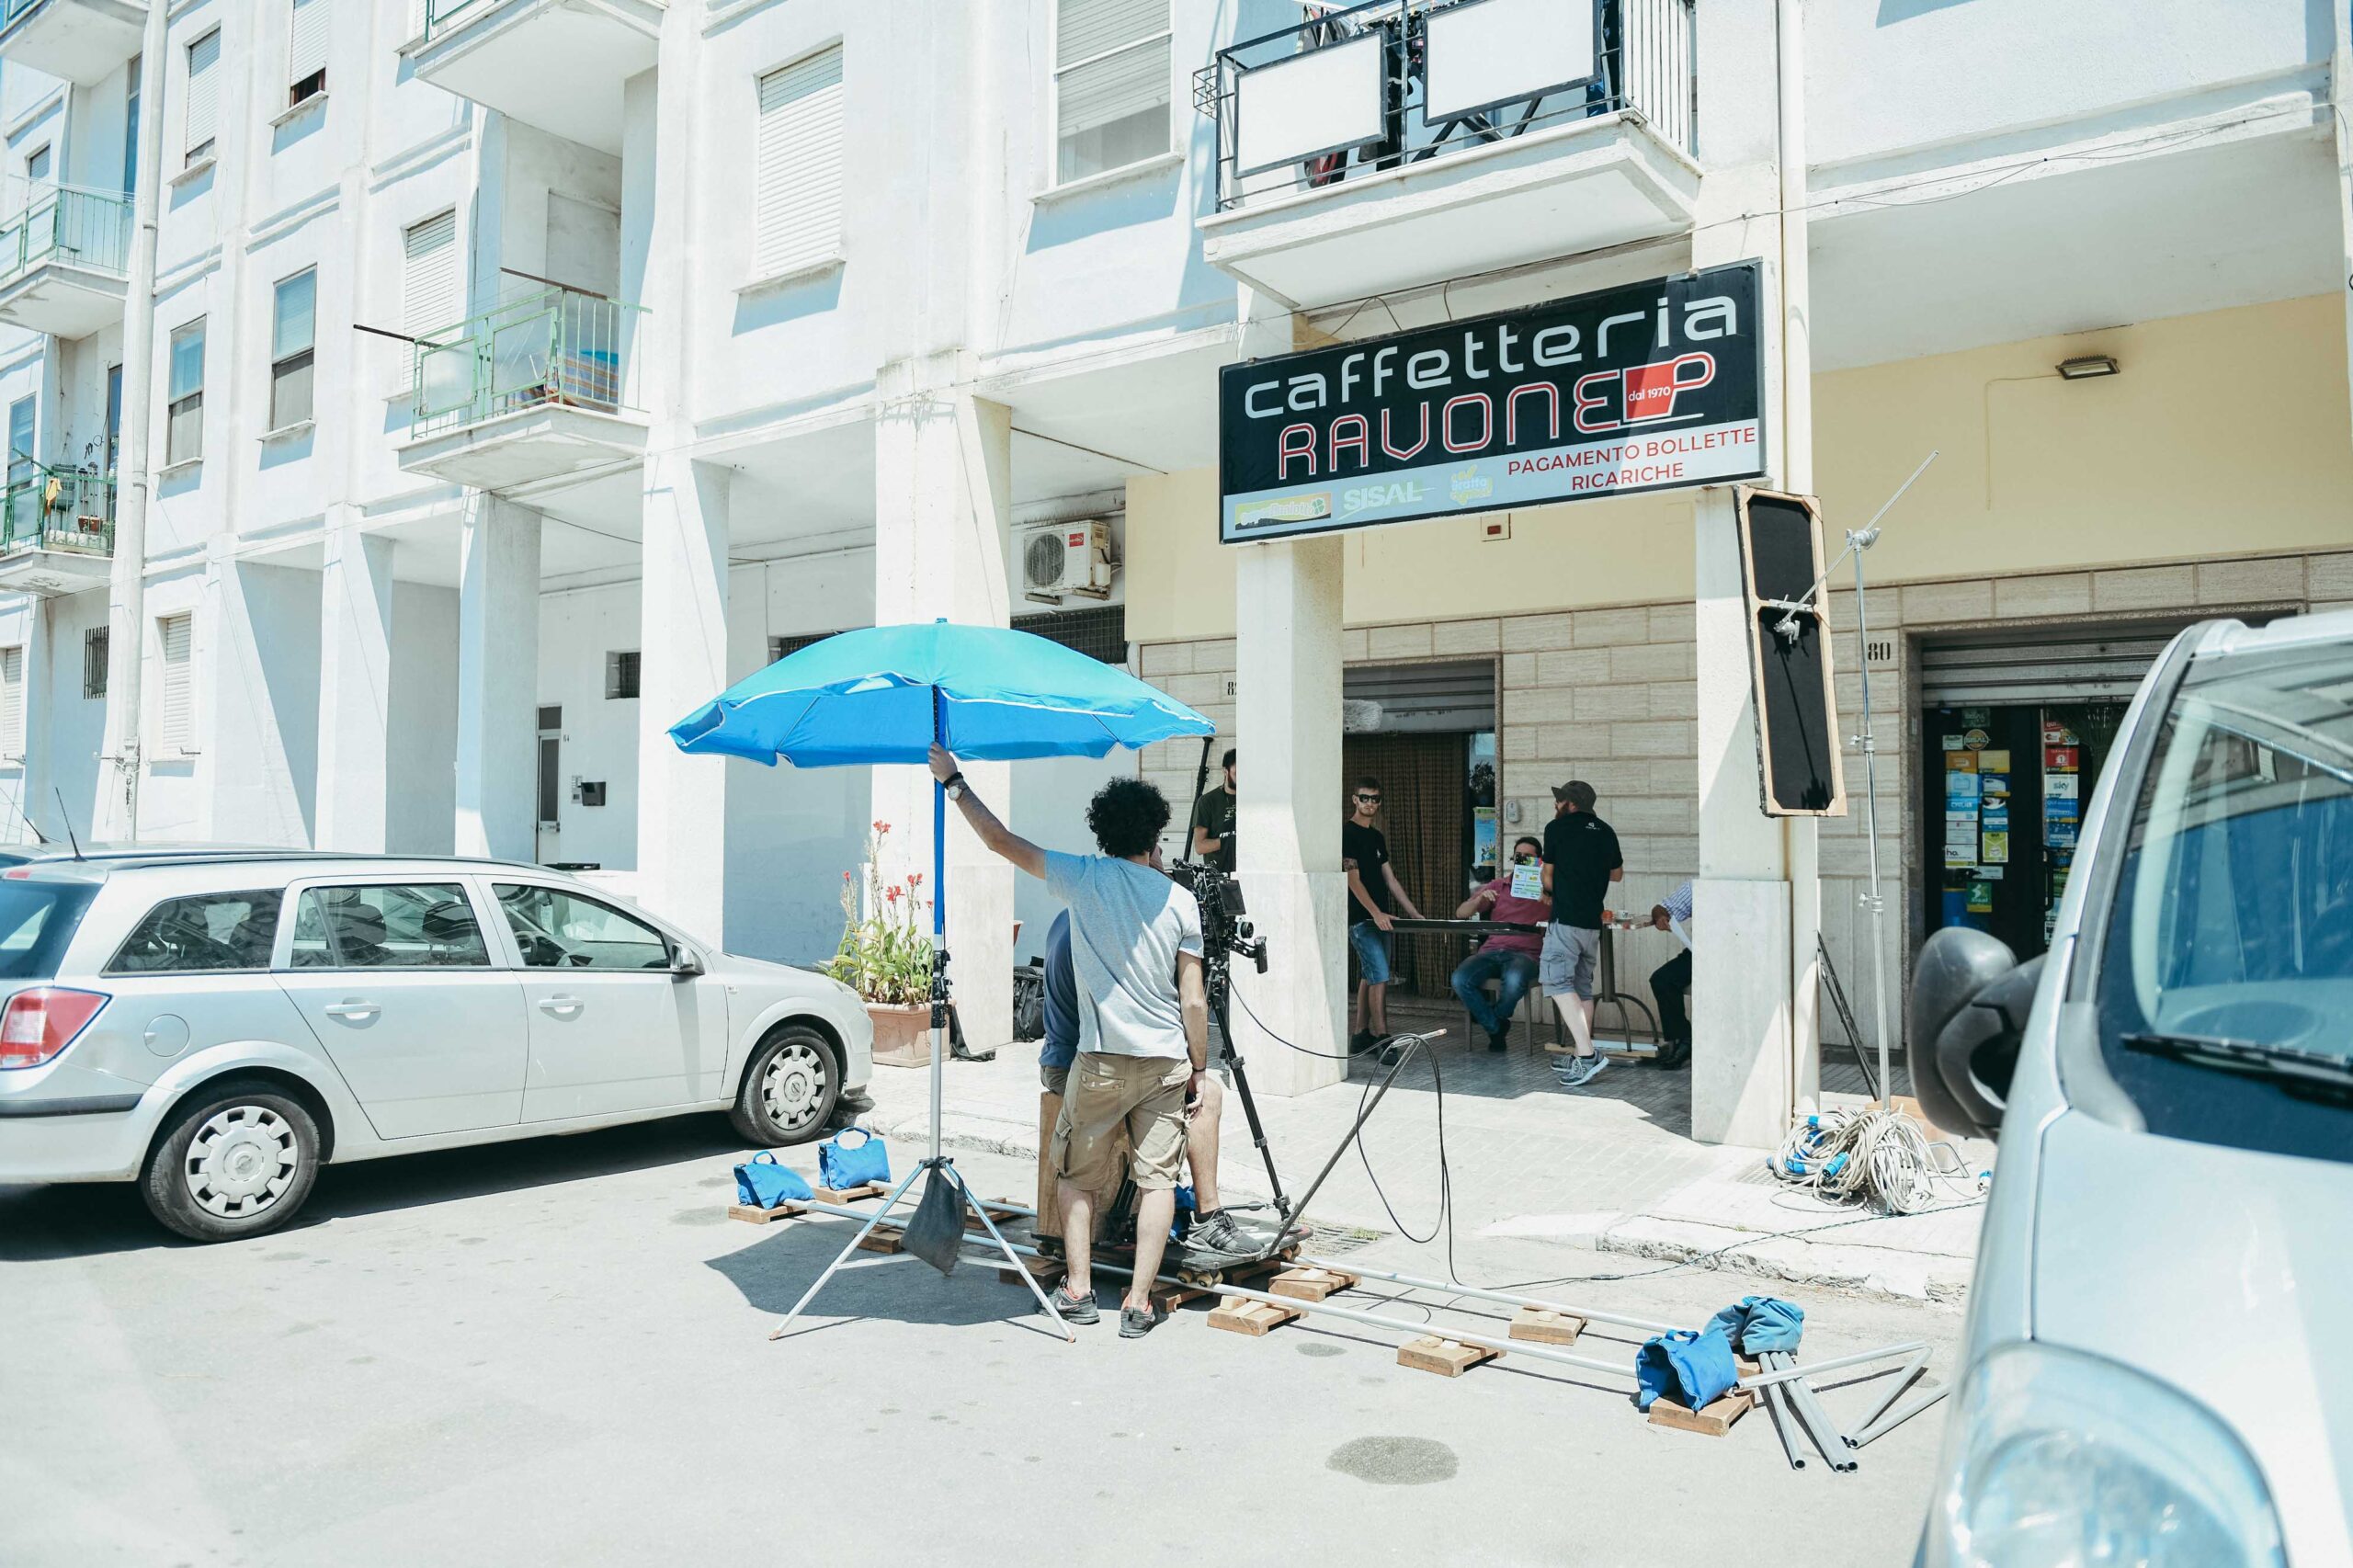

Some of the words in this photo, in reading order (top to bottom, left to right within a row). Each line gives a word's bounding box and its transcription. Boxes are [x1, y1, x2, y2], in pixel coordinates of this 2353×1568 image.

[1245, 295, 1737, 420] caffetteria
[1628, 389, 1645, 403] dal
[1648, 386, 1671, 400] 1970
[1508, 443, 1639, 476] PAGAMENTO
[1646, 426, 1756, 458] BOLLETTE
[1572, 462, 1684, 492] RICARICHE
[1344, 481, 1423, 511] SISAL
[1868, 642, 1891, 661] 80
[1227, 681, 1237, 696] 8
[2052, 780, 2070, 791] sky
